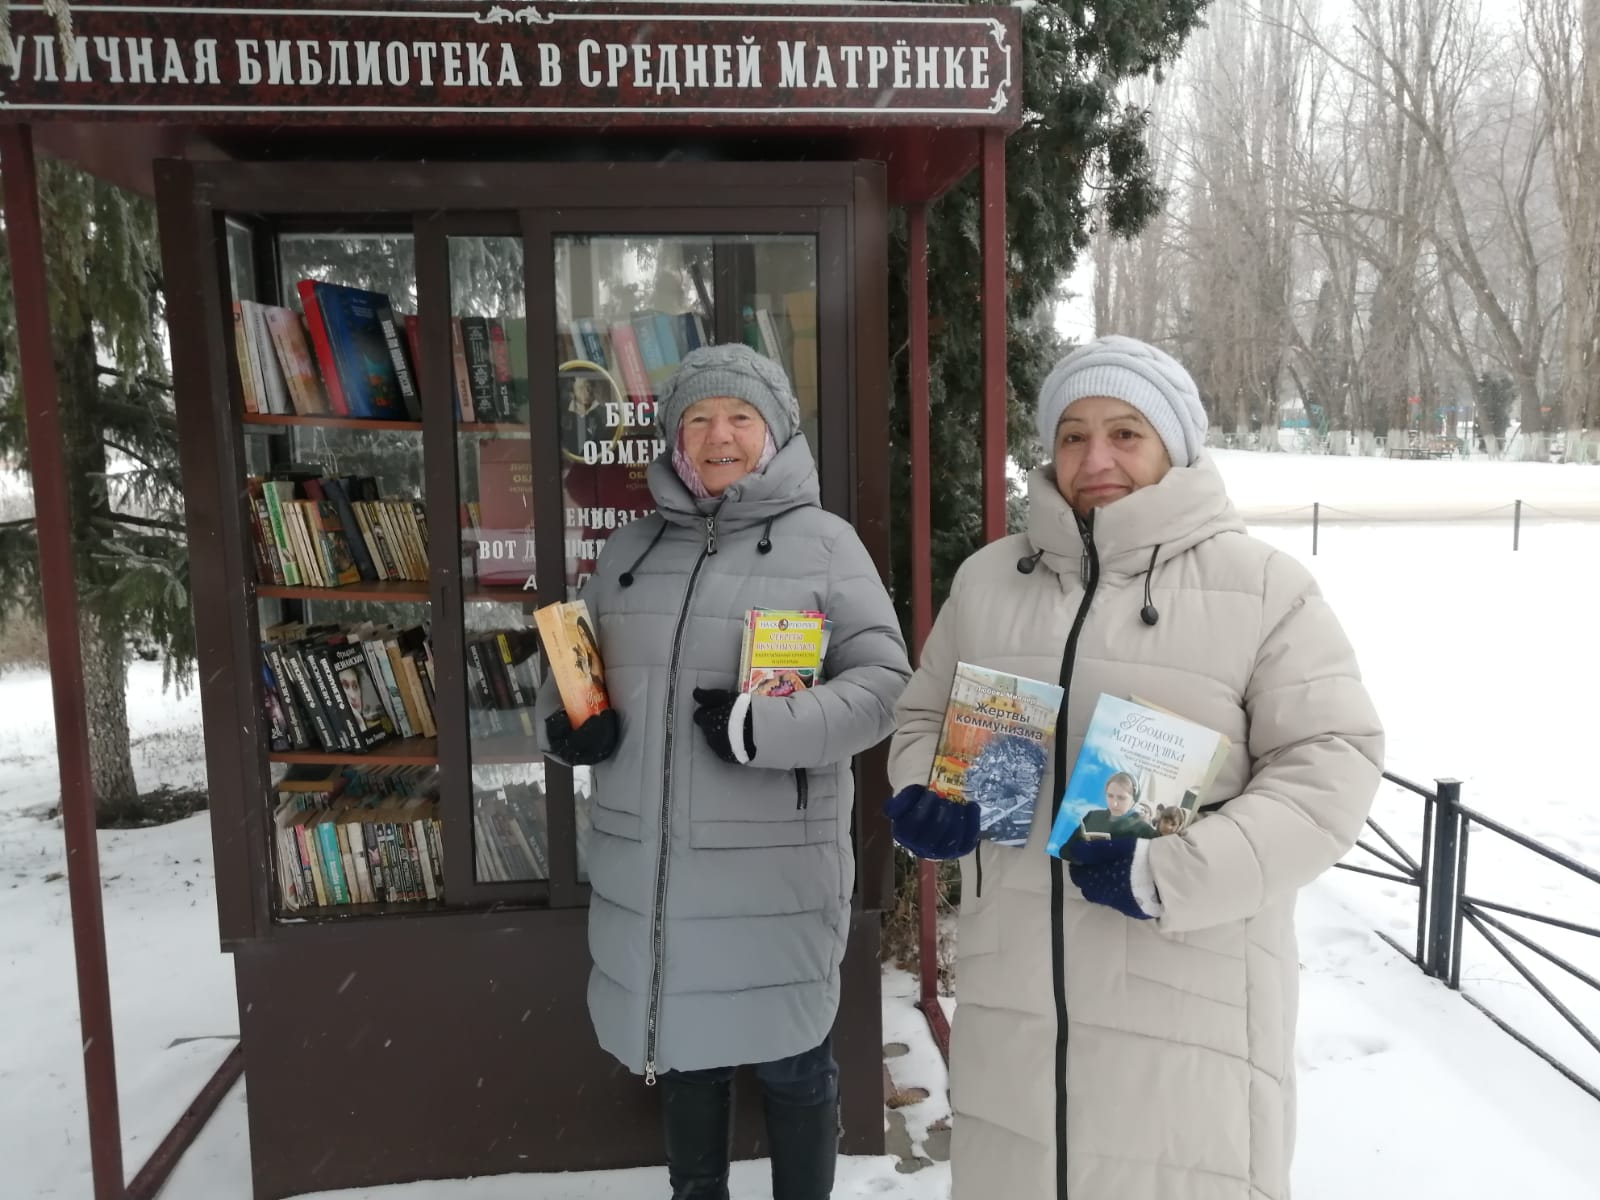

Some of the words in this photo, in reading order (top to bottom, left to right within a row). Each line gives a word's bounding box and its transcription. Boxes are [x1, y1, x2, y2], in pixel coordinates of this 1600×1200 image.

[235, 39, 522, 87] БИБЛИОТЕКА
[478, 540, 517, 560] ВОТ
[955, 713, 1044, 741] коммунизма
[974, 702, 1031, 724] Жертвы
[1111, 727, 1186, 763] Матронушка
